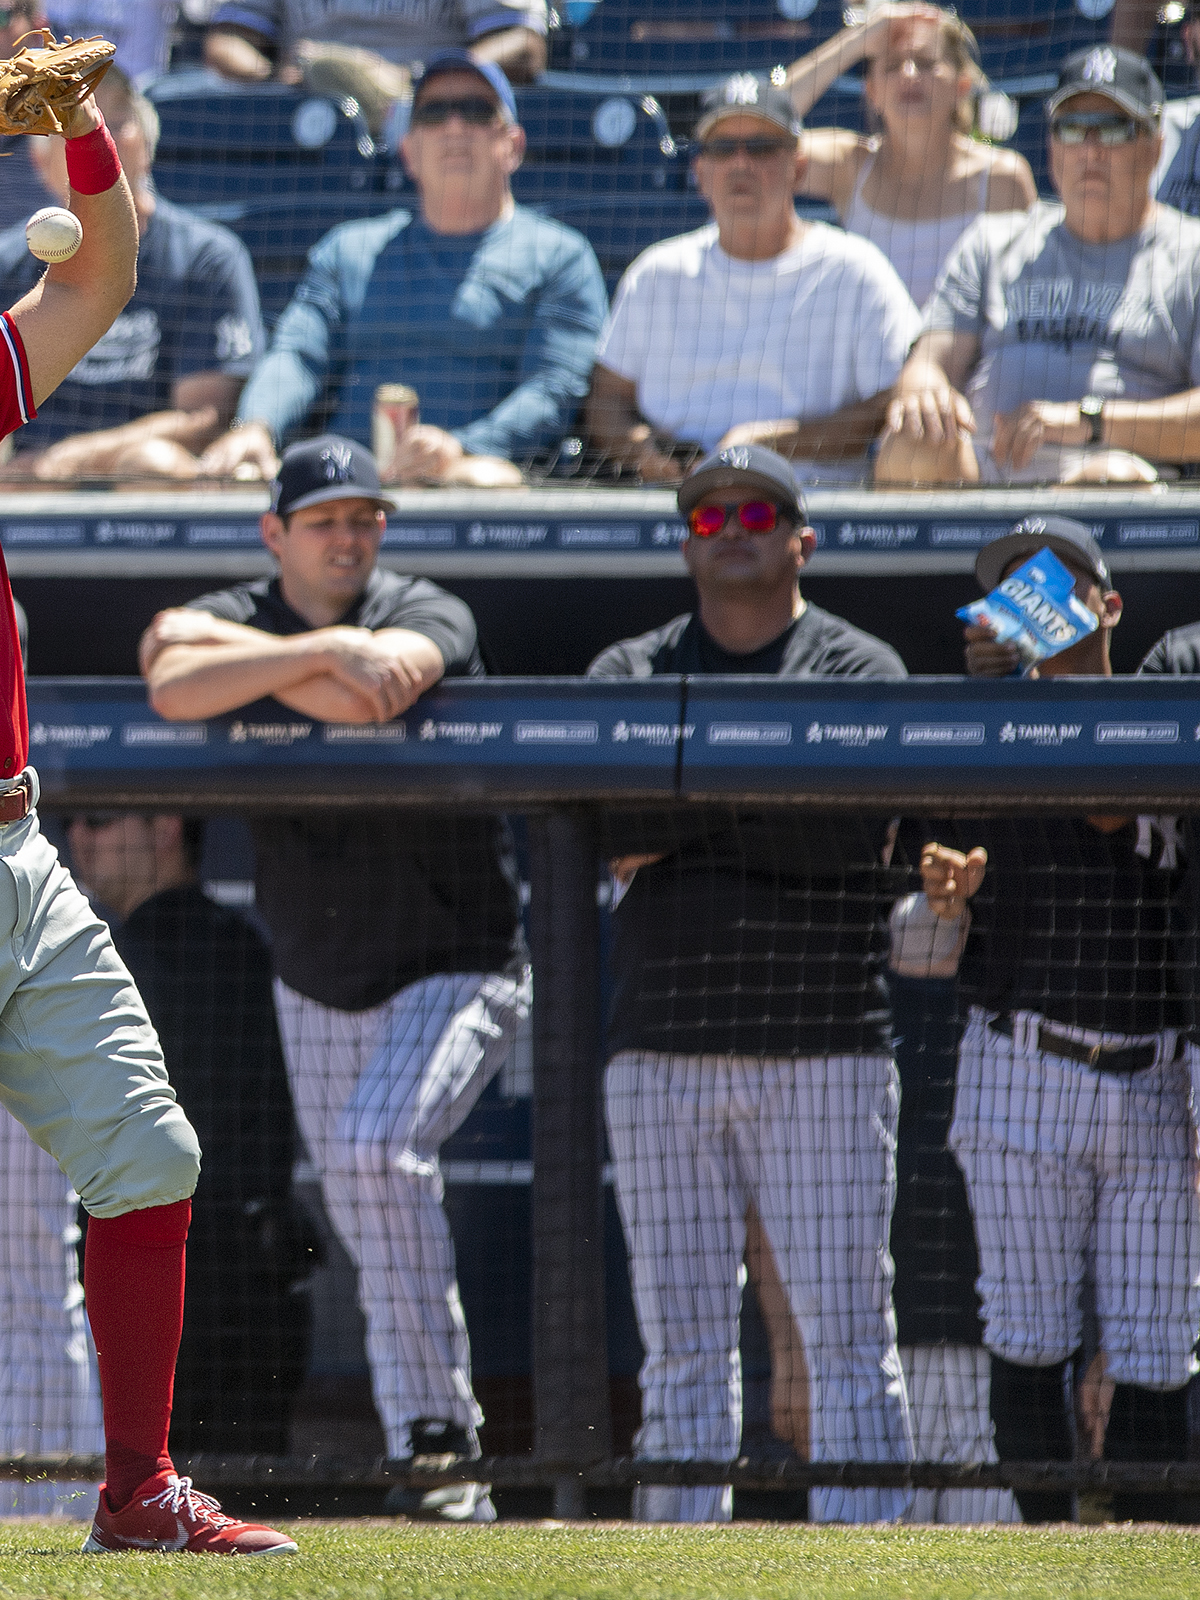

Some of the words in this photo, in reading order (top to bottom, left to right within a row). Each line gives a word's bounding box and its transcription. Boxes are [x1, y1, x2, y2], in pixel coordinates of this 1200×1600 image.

[999, 577, 1078, 643] GIANTS
[438, 722, 479, 738] TAMPA
[481, 722, 503, 738] BAY
[629, 723, 669, 739] TAMPA
[824, 724, 864, 740] TAMPA
[866, 724, 888, 740] BAY
[904, 727, 982, 743] yankees.com
[1018, 724, 1058, 740] TAMPA
[1060, 724, 1082, 740] BAY
[1099, 725, 1176, 741] yankees.com
